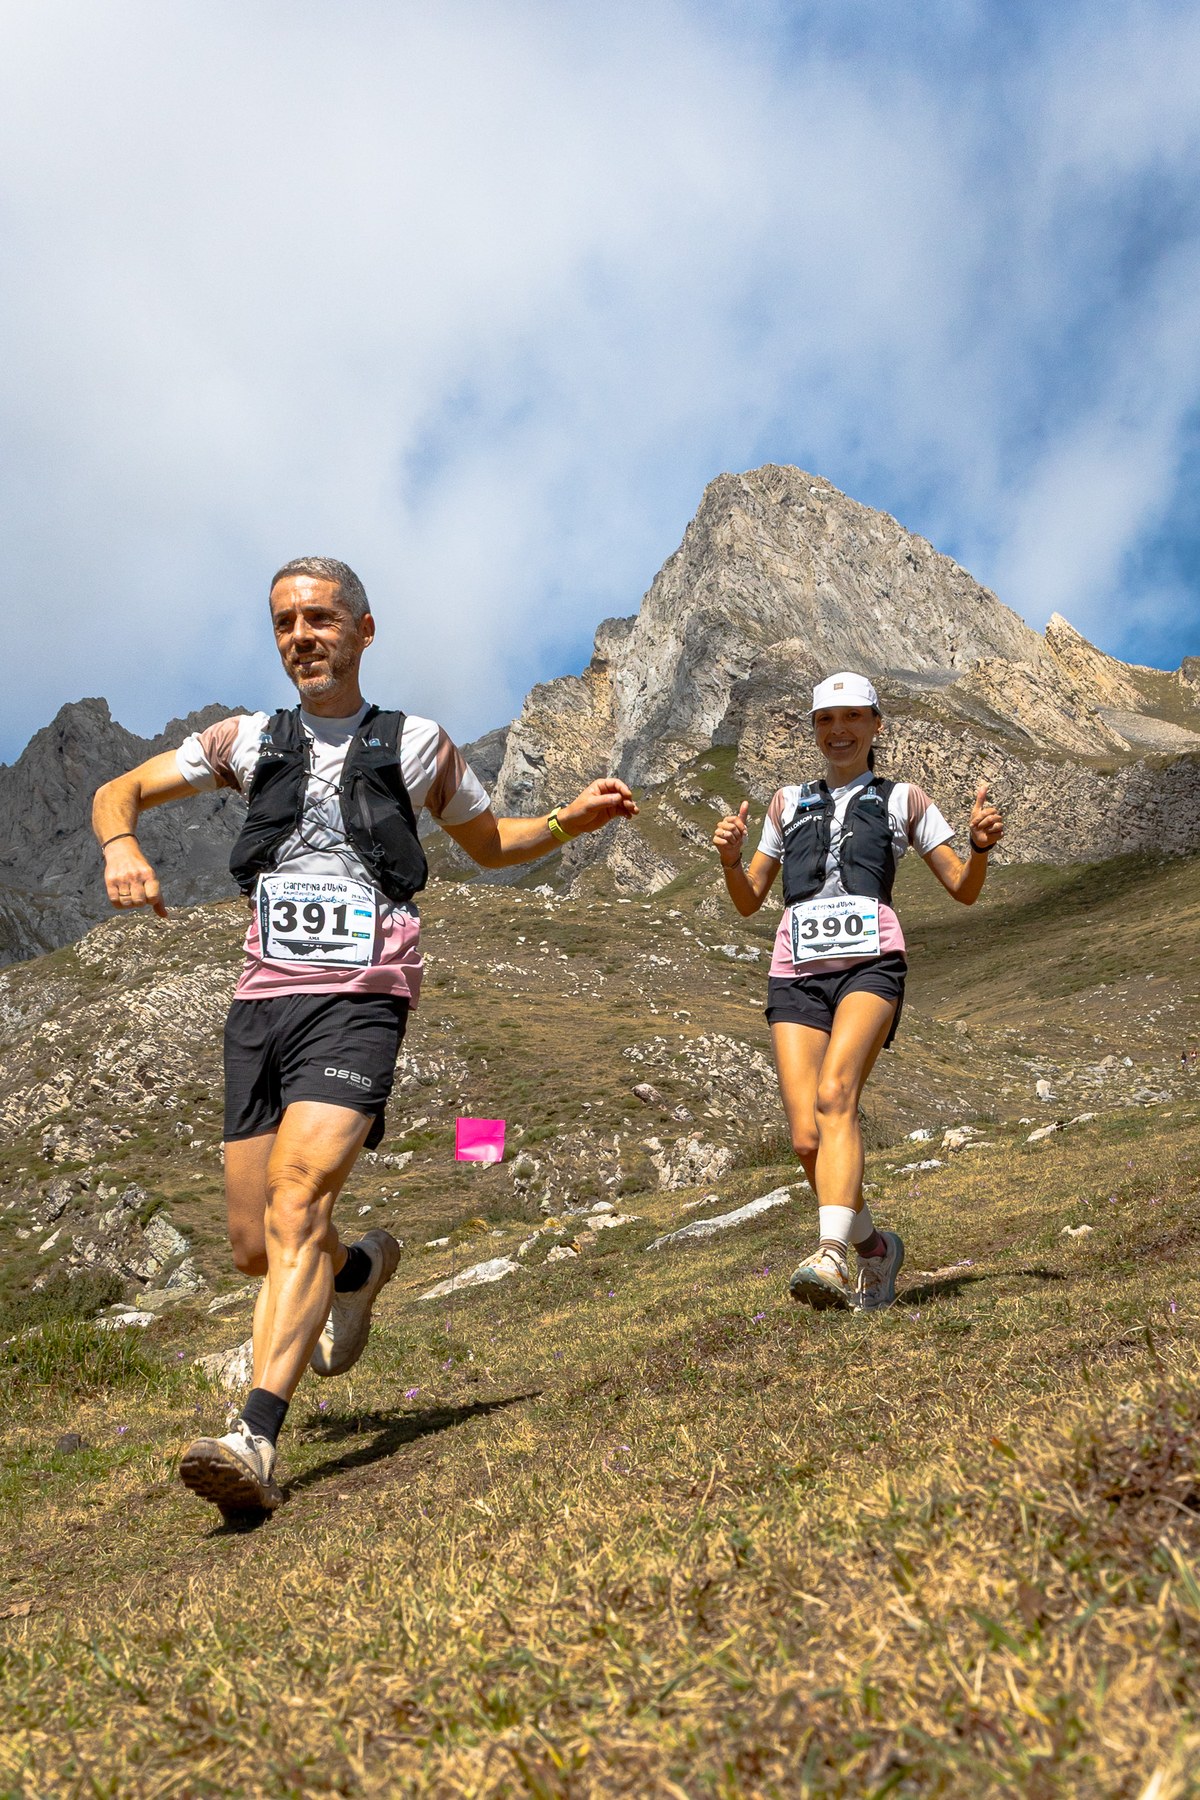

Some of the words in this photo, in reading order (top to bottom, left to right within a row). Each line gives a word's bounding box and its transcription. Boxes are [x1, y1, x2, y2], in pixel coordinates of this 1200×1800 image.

[784, 814, 813, 837] SALOMON
[272, 901, 349, 937] 391
[800, 914, 863, 940] 390
